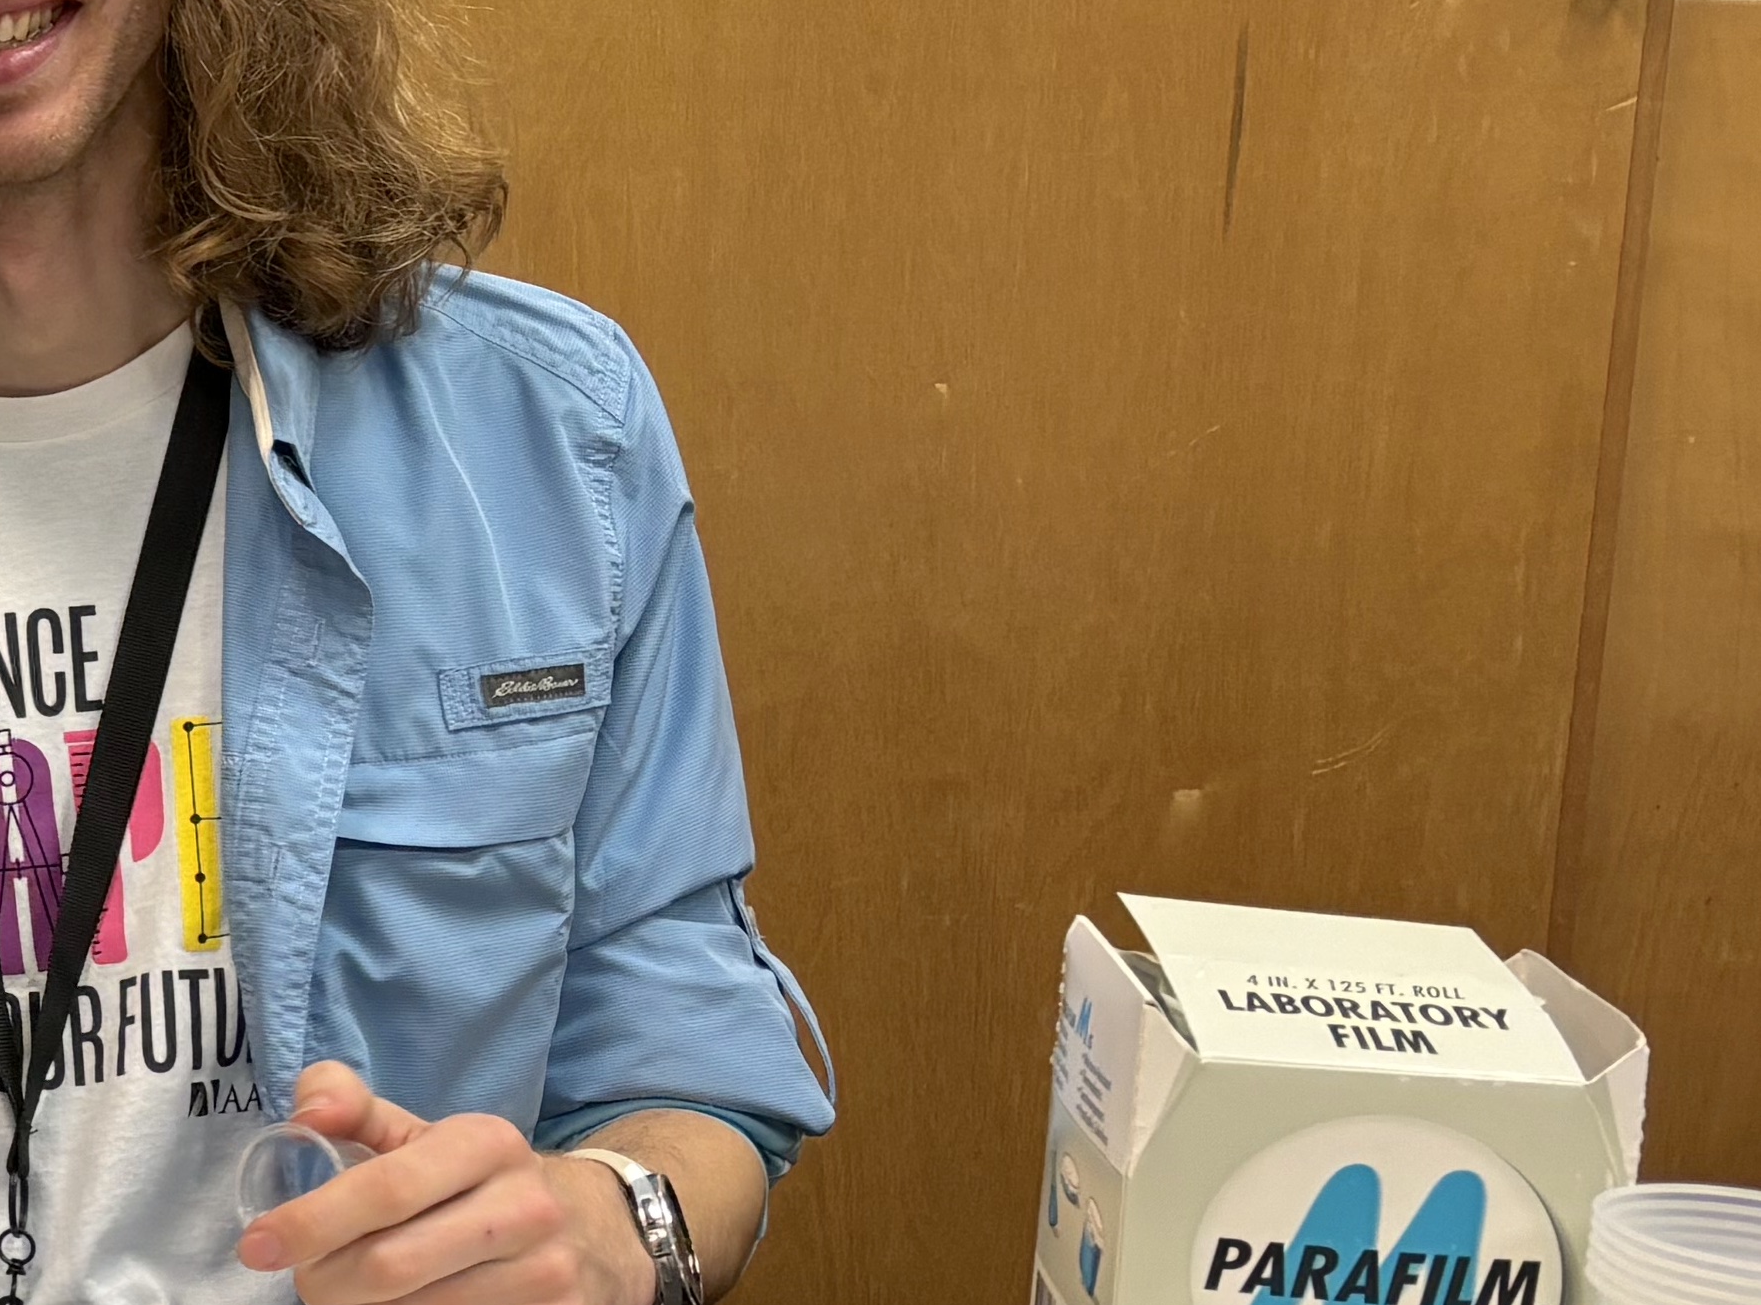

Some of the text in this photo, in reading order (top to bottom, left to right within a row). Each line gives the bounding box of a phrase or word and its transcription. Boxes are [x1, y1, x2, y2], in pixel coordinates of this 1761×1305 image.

[1247, 974, 1466, 1000] 4 IN. X 125 FT. ROLL
[116, 967, 253, 1077] FUTU
[1217, 989, 1510, 1031] LABORATORY
[1327, 1023, 1439, 1055] FILM
